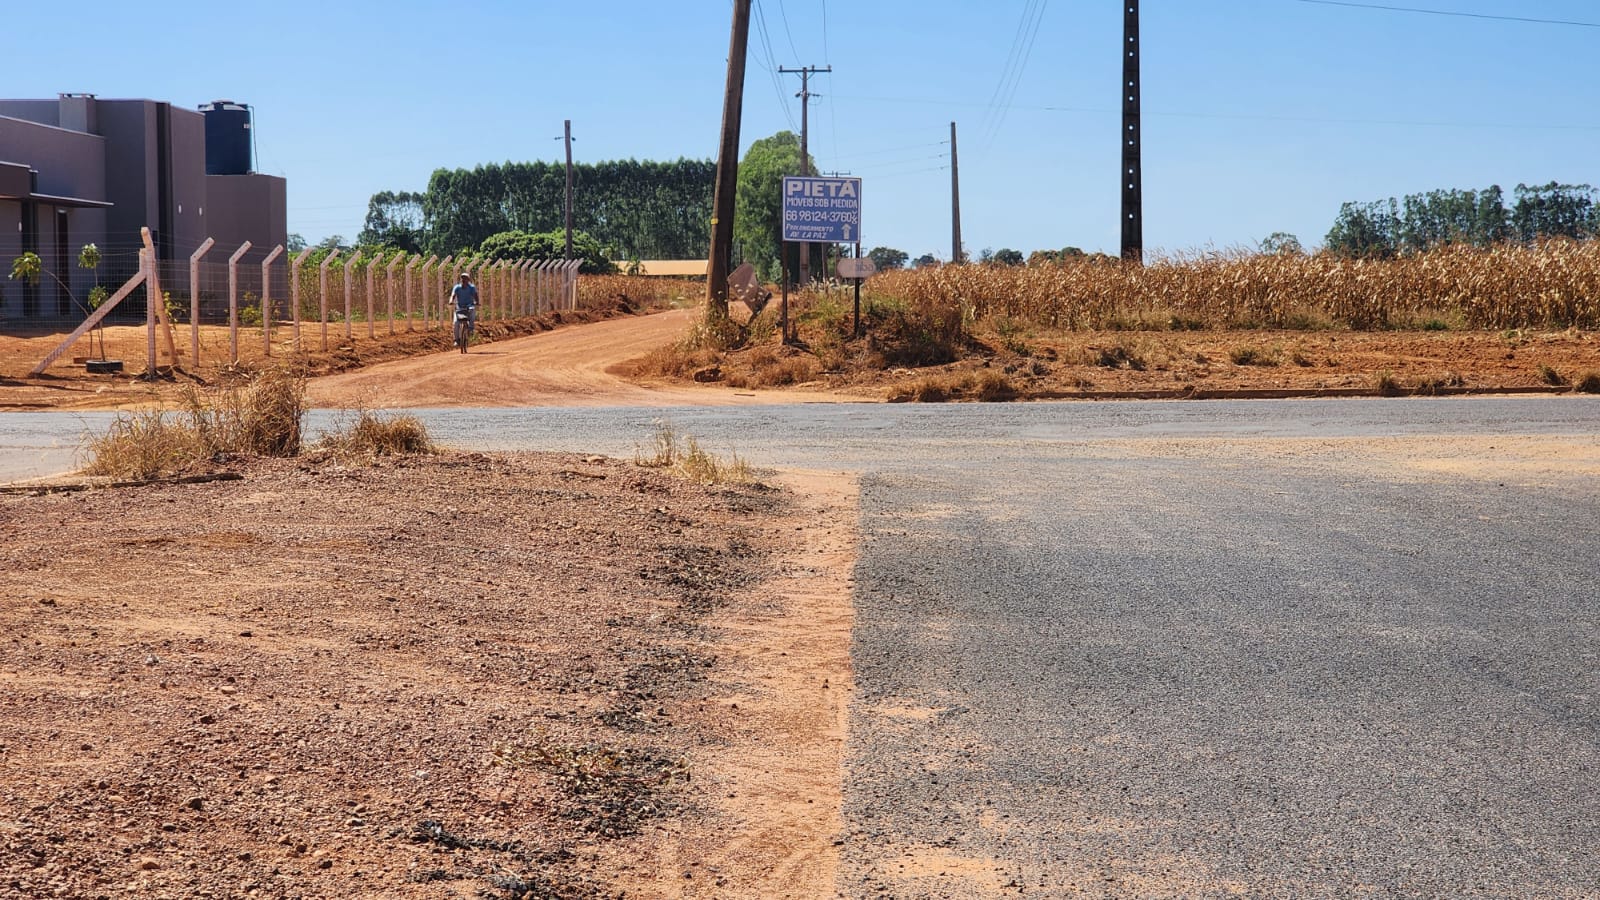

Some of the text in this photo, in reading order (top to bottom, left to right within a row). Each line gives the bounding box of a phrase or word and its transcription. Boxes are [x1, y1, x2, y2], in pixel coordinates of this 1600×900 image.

[787, 180, 856, 197] PIETÁ
[814, 198, 829, 207] SOB
[831, 199, 857, 209] MEDIDA
[786, 210, 797, 221] 66
